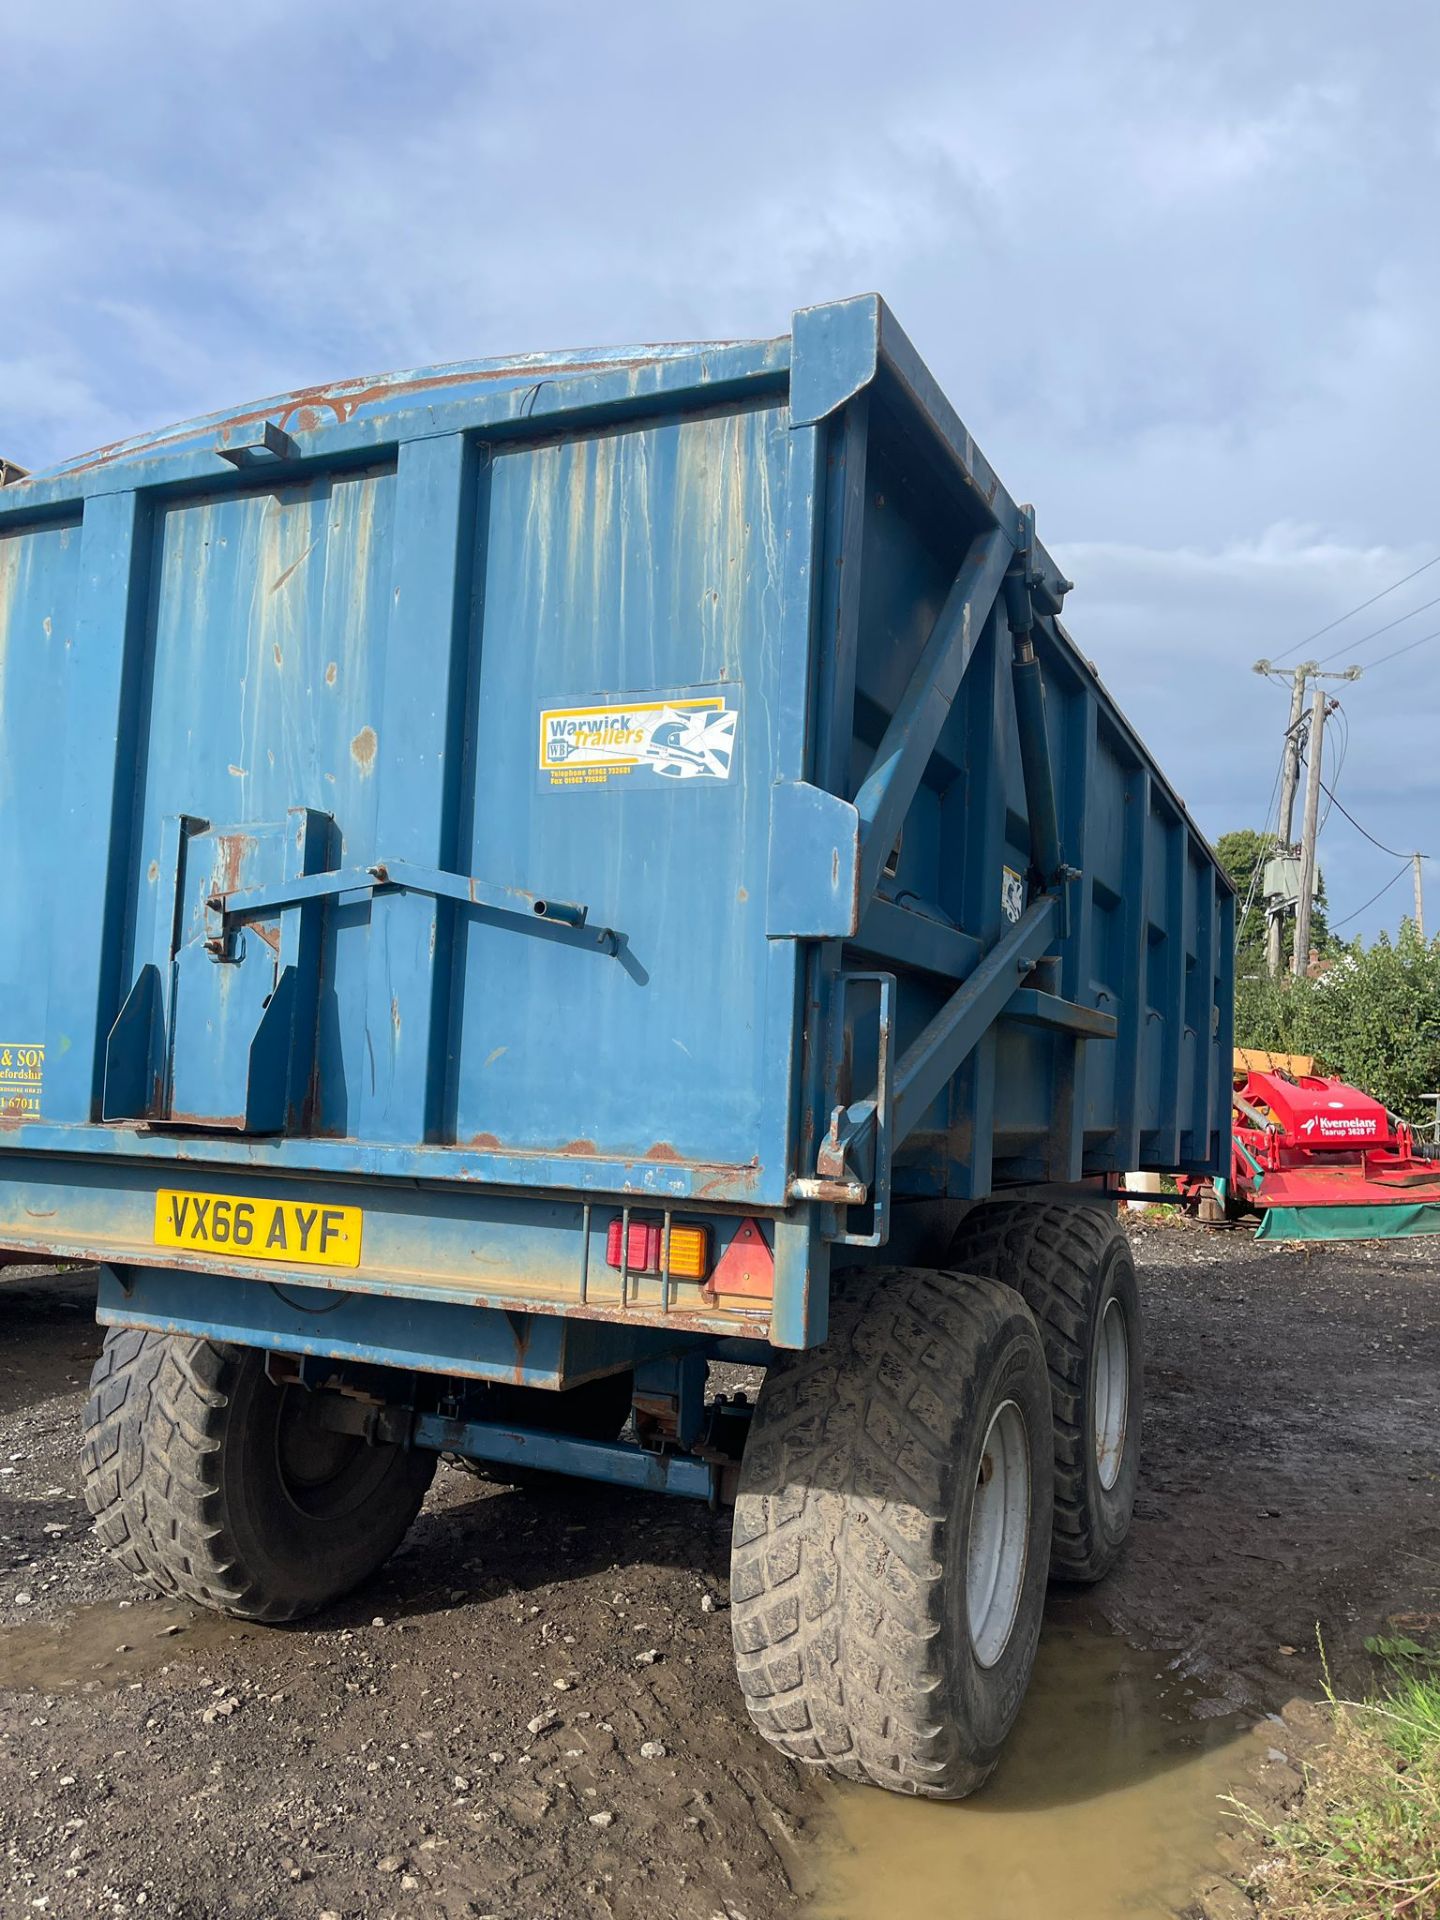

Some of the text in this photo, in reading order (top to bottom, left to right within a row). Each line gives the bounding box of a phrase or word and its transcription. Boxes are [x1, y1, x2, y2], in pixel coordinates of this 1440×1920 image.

[550, 715, 631, 737] Warwick
[573, 727, 645, 747] Trailers
[550, 744, 566, 756] WB
[550, 769, 586, 777] Telephone
[550, 777, 563, 785] Fax
[1, 1049, 13, 1066] &
[9, 1097, 40, 1110] 67011
[1320, 1128, 1347, 1136] Taarup
[1366, 1127, 1376, 1135] FT
[171, 1195, 345, 1254] VX66 AYF
